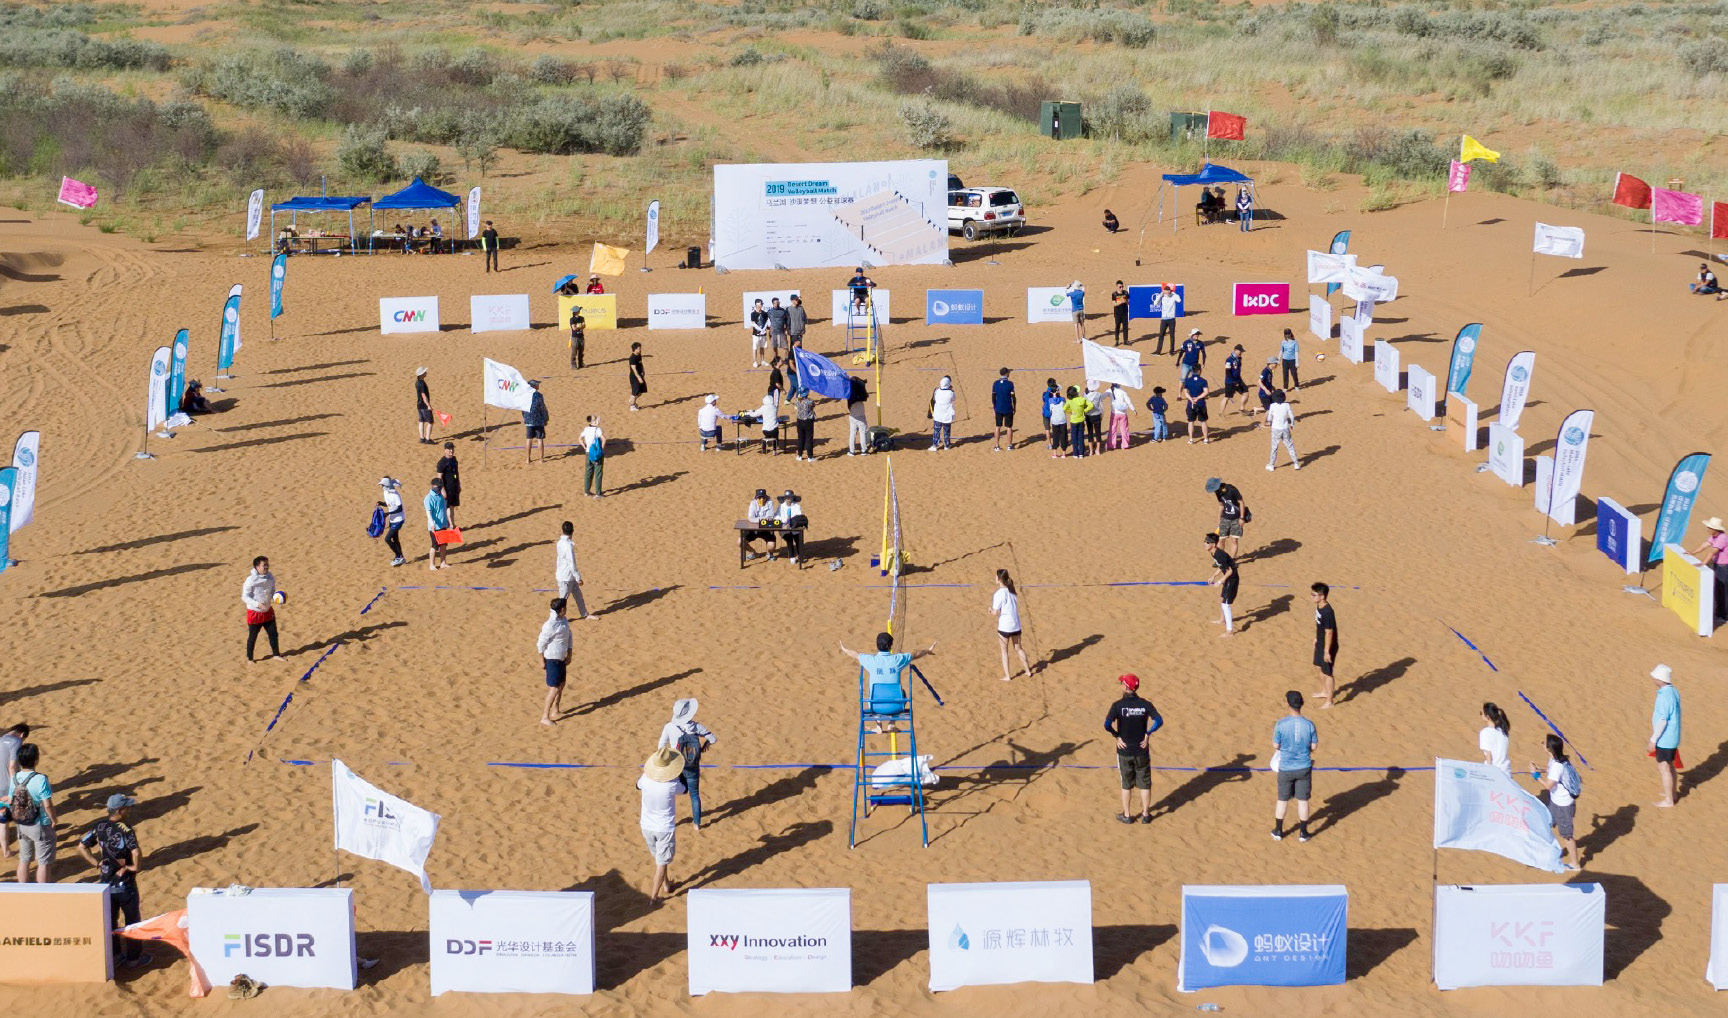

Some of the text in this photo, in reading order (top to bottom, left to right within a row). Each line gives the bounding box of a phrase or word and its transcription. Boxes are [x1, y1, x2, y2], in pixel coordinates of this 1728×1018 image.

[767, 185, 785, 194] 2019
[1243, 294, 1280, 307] IxDC
[744, 934, 827, 947] Innovation
[983, 928, 1074, 950] 源辉林牧
[1491, 921, 1554, 947] KKF
[0, 937, 52, 946] ANFIELD
[223, 933, 315, 957] FISDR
[446, 939, 577, 955] DDF 光华设计基金会
[1254, 932, 1329, 953] 蚂蚁设计
[1284, 954, 1329, 962] DESIGN
